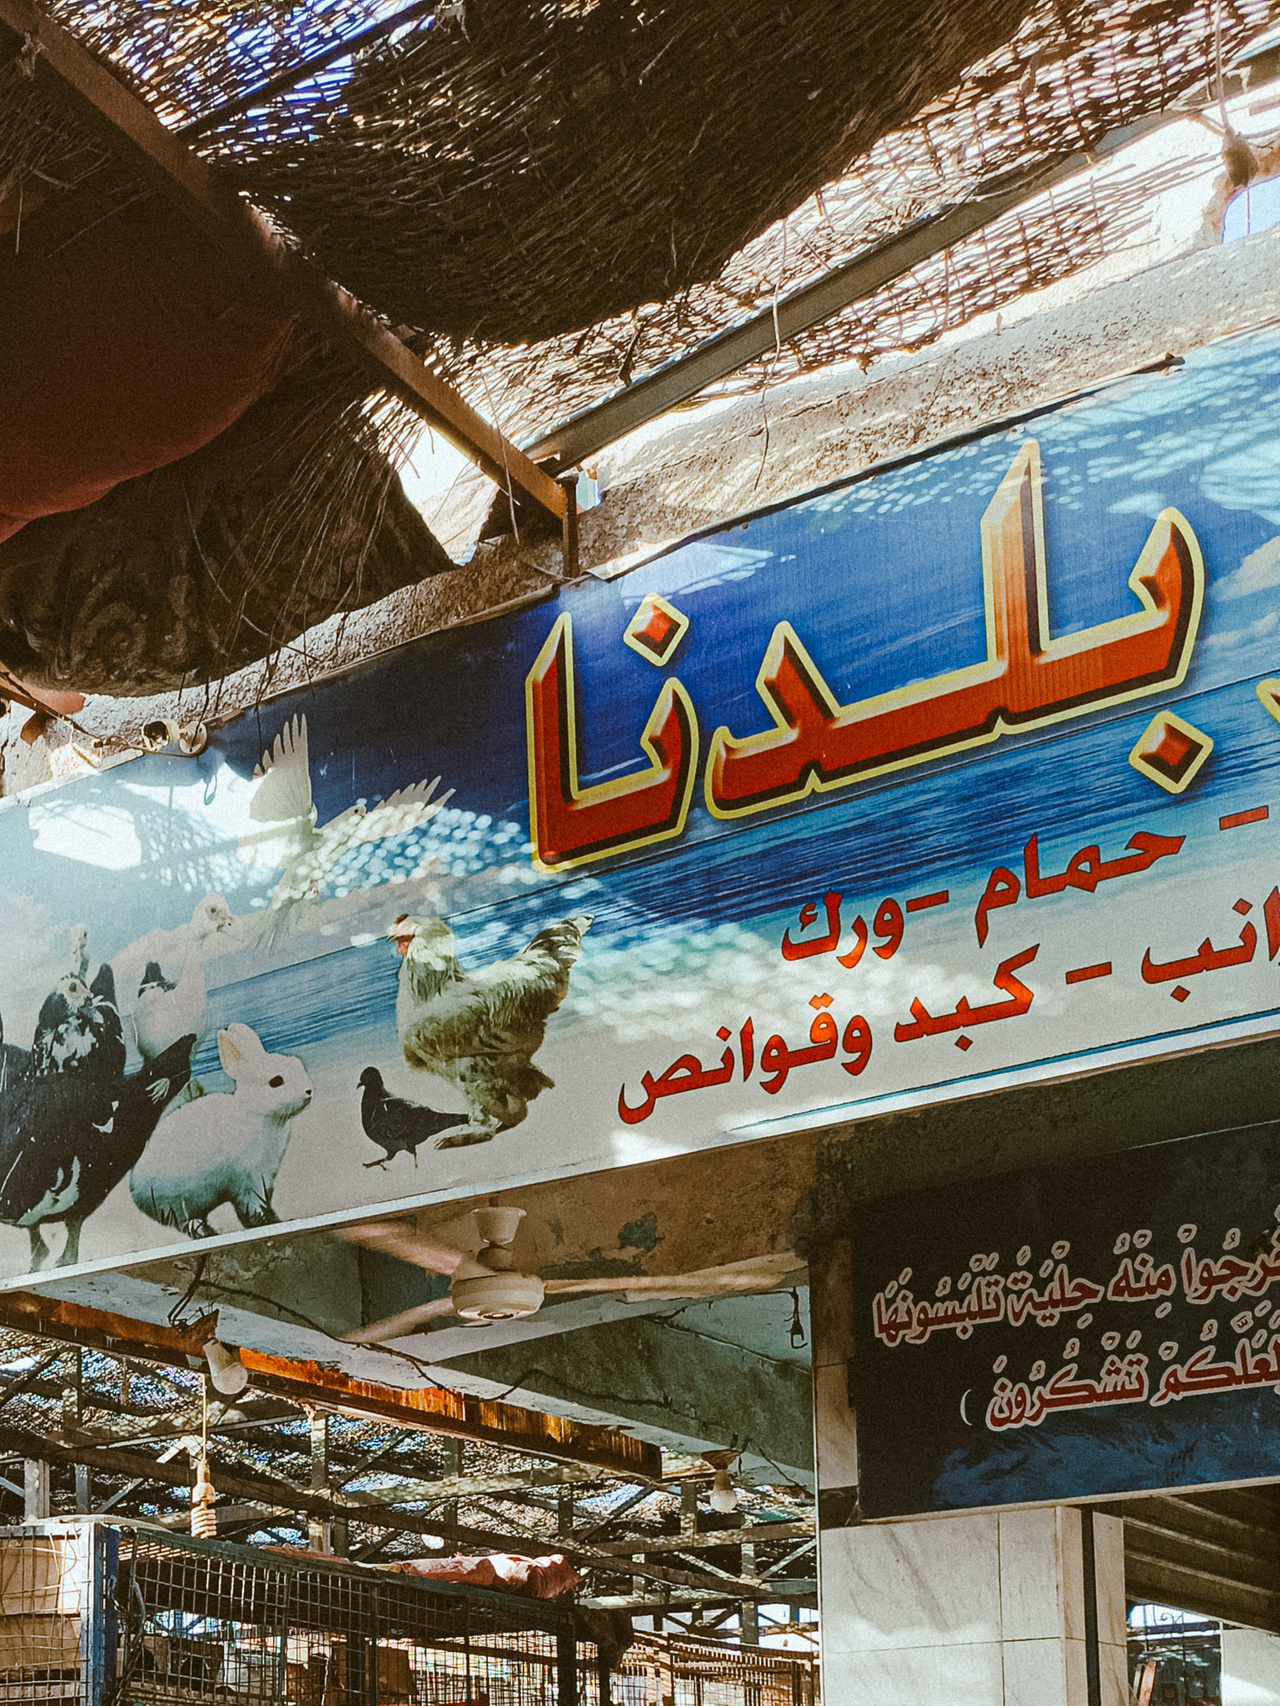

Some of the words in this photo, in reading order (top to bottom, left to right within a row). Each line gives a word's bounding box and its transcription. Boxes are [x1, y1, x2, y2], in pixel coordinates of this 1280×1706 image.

[526, 438, 1213, 872] بلدنا
[974, 831, 1186, 948] حمام
[1141, 886, 1280, 1003] انب
[893, 943, 1041, 1051] كبد
[617, 993, 873, 1125] وقوانص
